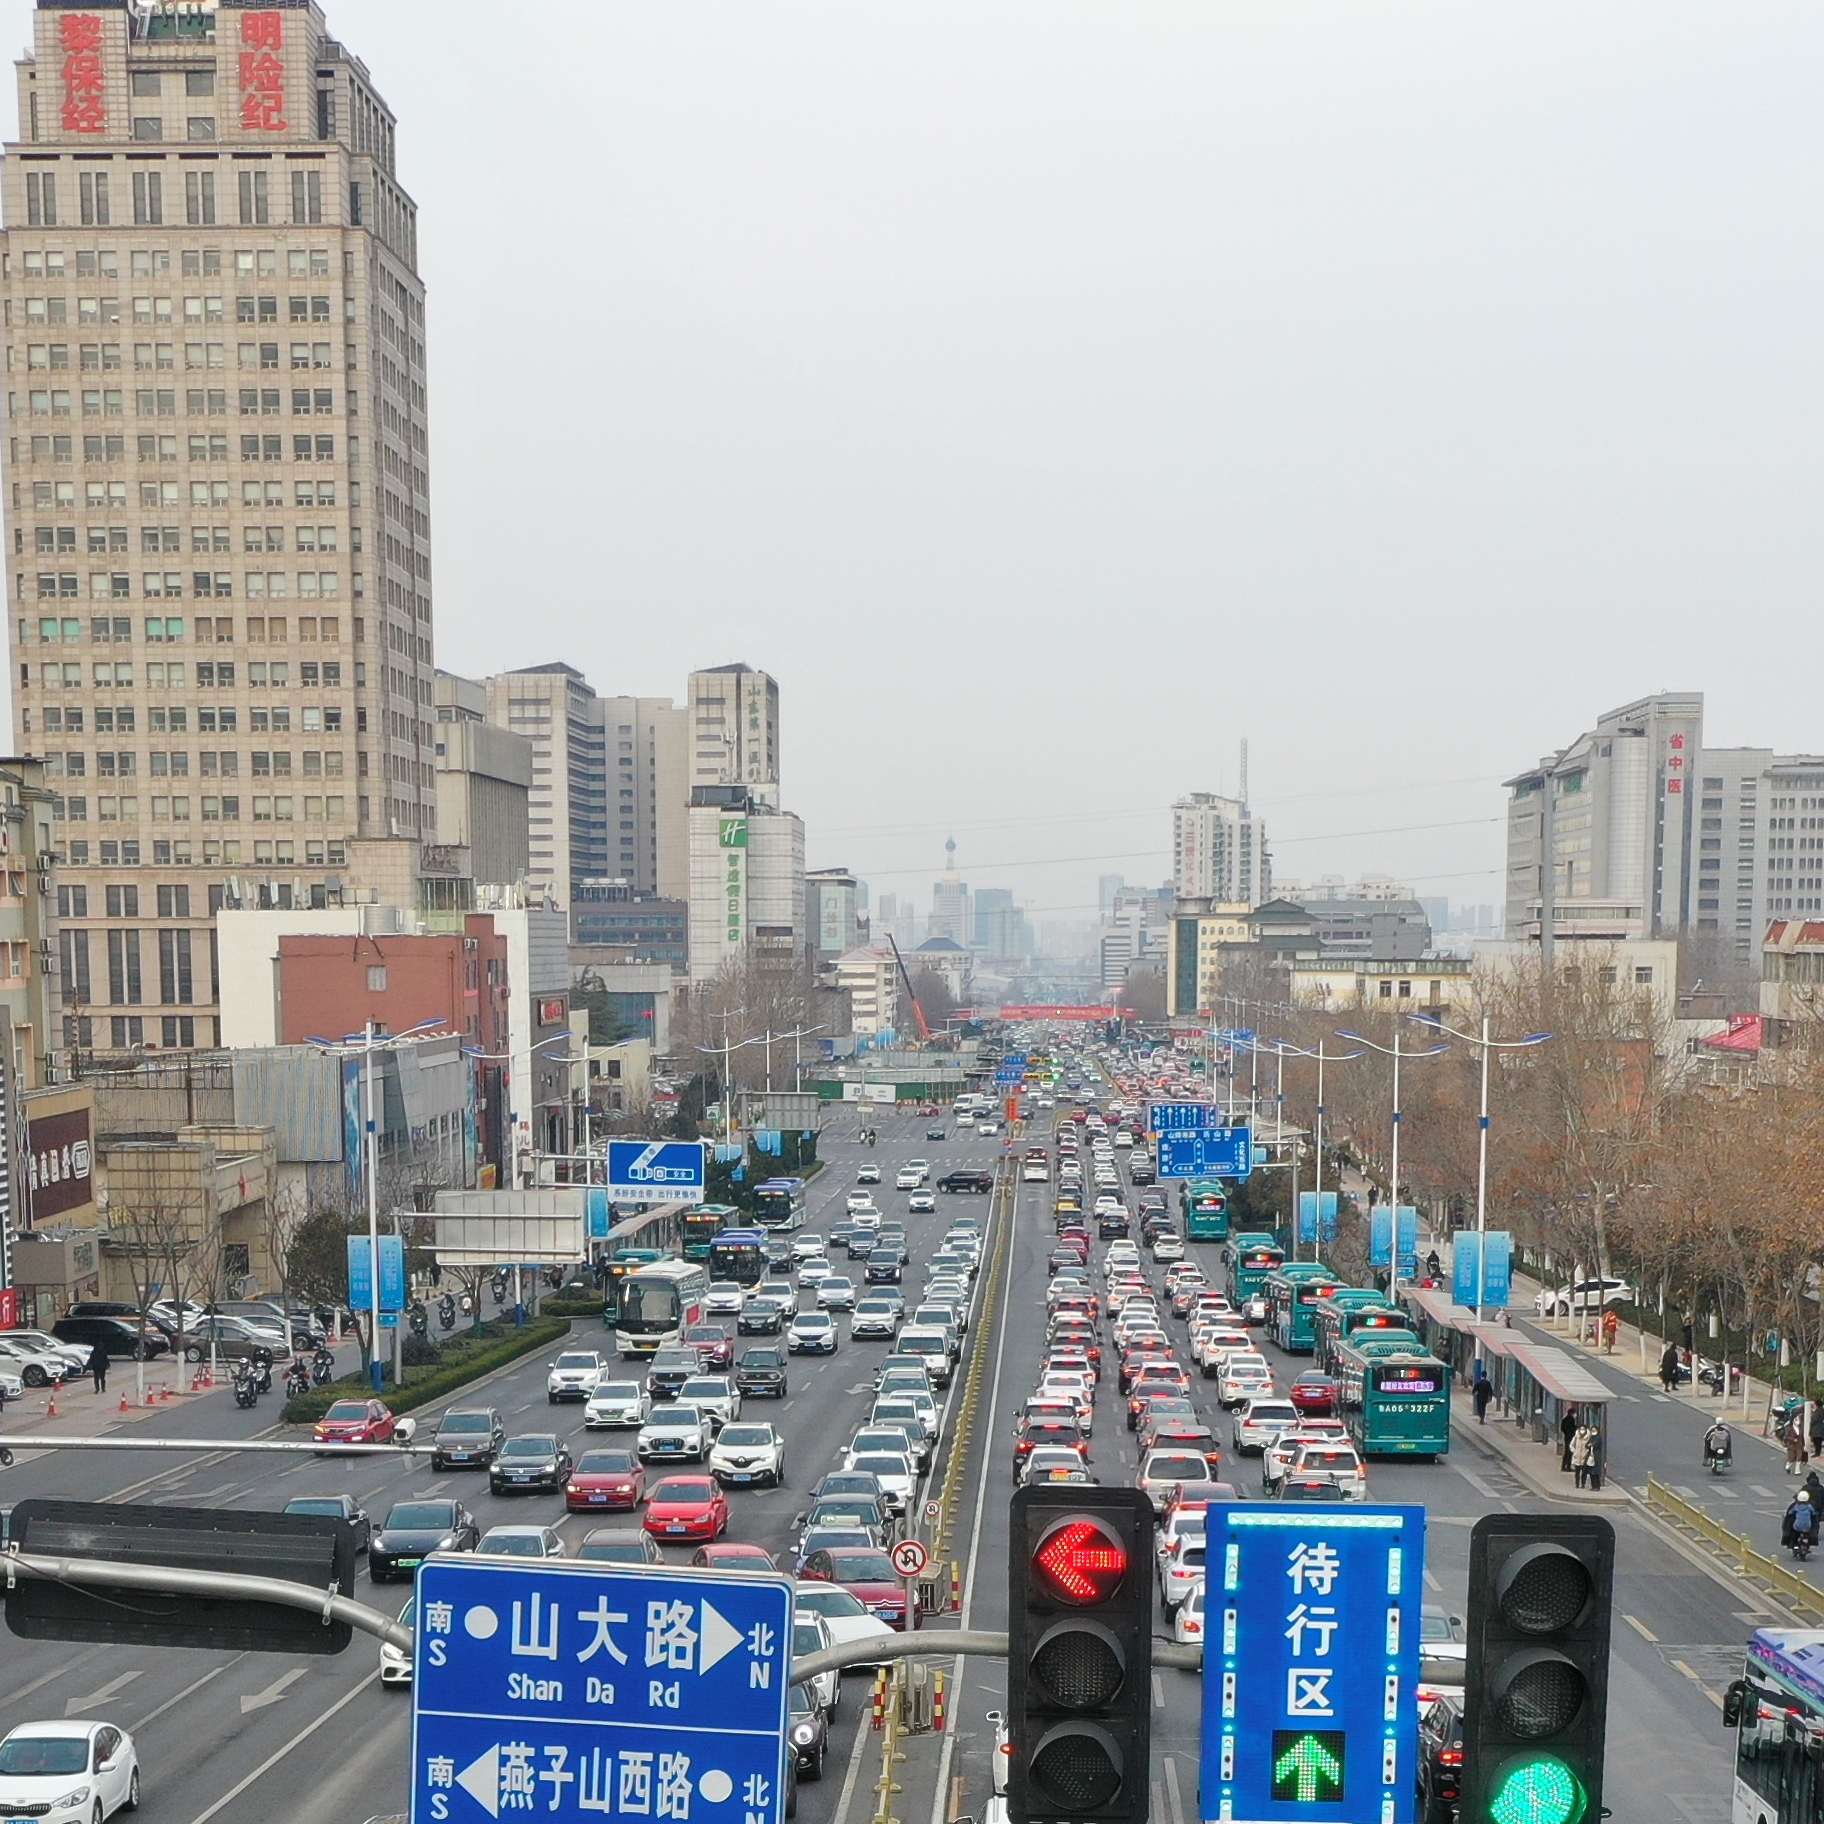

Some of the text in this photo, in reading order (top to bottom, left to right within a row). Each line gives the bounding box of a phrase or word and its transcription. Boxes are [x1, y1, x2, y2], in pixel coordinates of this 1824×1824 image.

[1668, 733, 1684, 793] 省中医
[425, 1601, 453, 1635] 南
[511, 1592, 698, 1670] 山大路
[1286, 1541, 1339, 1717] 待行区
[428, 1639, 447, 1667] S
[748, 1622, 775, 1656] 北
[507, 1673, 680, 1708] Shan Da Rd
[749, 1662, 770, 1689] N
[427, 1755, 455, 1789] 南
[500, 1741, 693, 1820] 燕子山西路
[430, 1793, 449, 1821] S
[743, 1773, 770, 1807] 北
